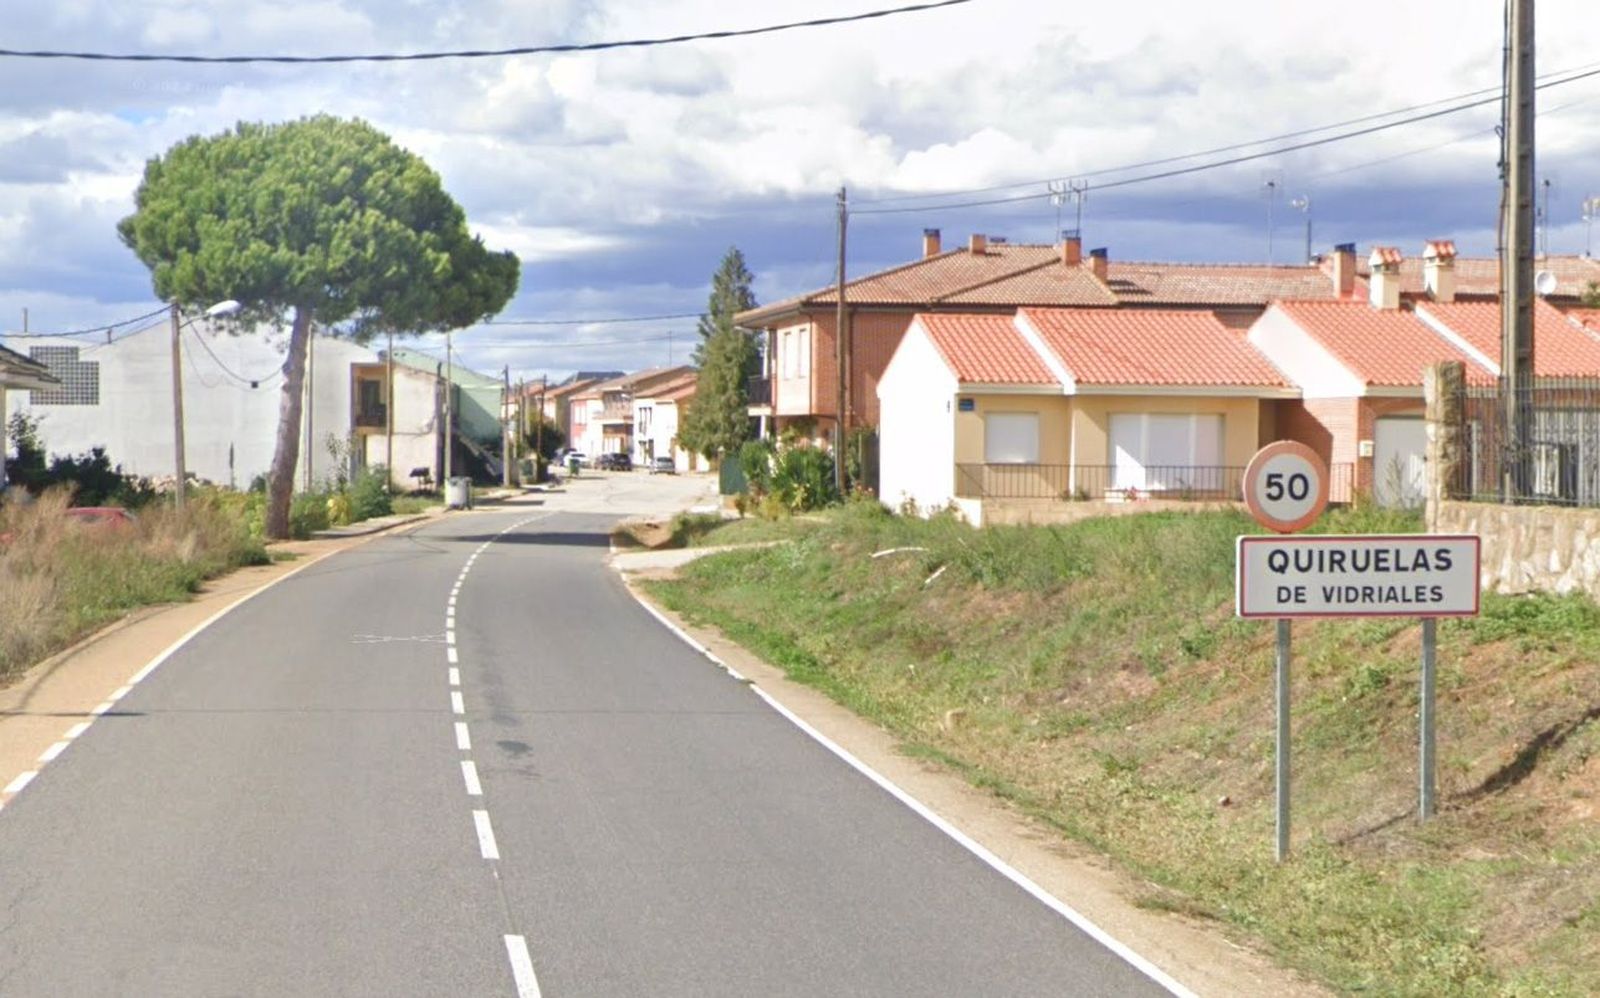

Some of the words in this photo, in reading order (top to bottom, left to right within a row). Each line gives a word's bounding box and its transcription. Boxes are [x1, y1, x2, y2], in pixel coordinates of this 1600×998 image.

[1265, 473, 1310, 501] 50
[1267, 548, 1453, 575] QUIRUELAS
[1277, 586, 1307, 604] DE
[1322, 585, 1443, 604] VIDRIALES
